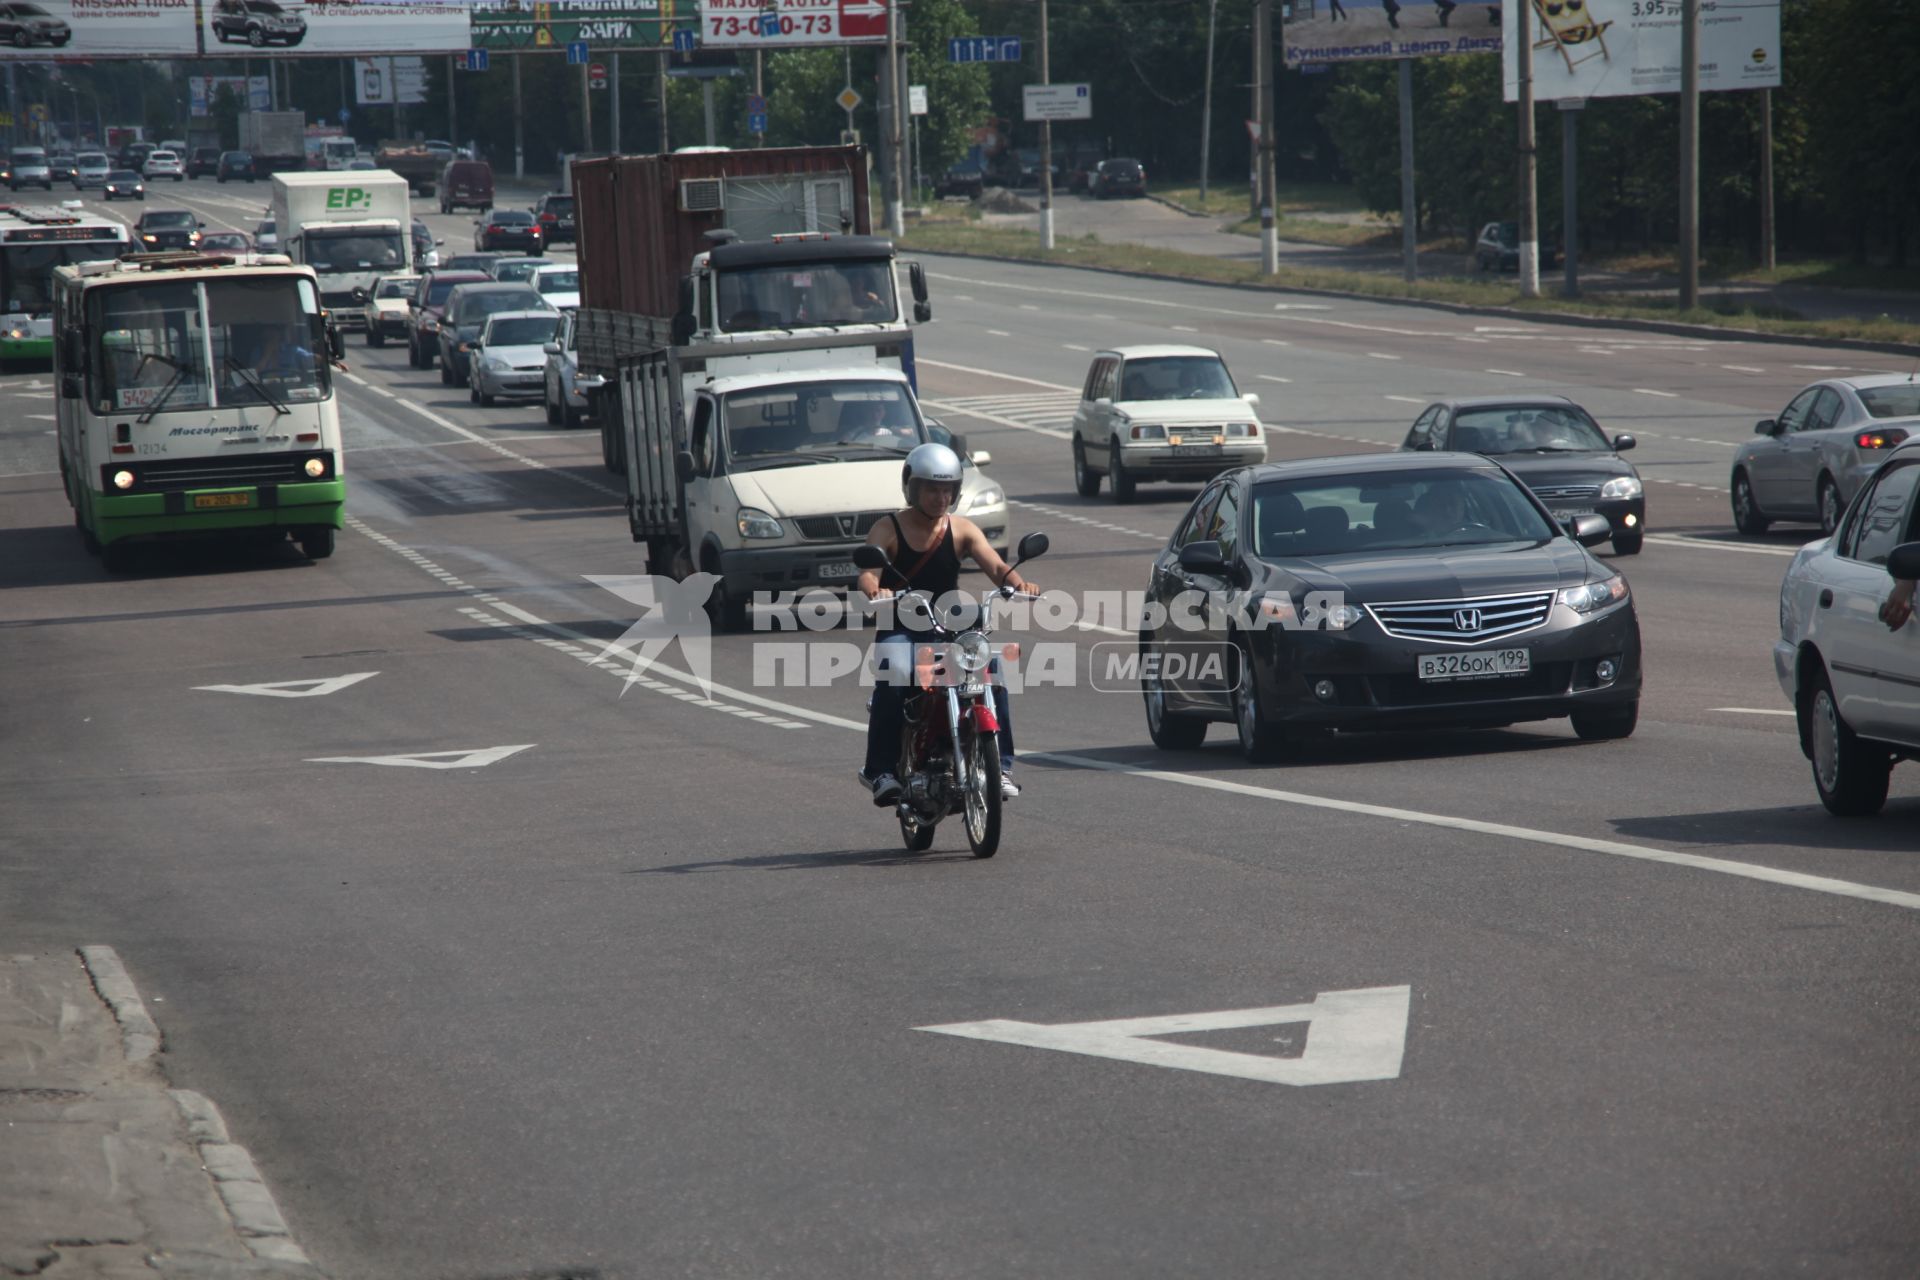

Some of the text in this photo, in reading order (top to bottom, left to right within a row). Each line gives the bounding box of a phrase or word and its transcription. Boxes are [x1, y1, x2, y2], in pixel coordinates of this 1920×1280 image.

[72, 0, 137, 8] NISSAN
[1632, 0, 1664, 16] 3,95
[711, 15, 832, 36] 73-00-73
[1287, 42, 1392, 61] Кунцевский
[1399, 40, 1451, 56] центр
[169, 424, 260, 437] Мосгортранс
[1499, 650, 1524, 665] 199
